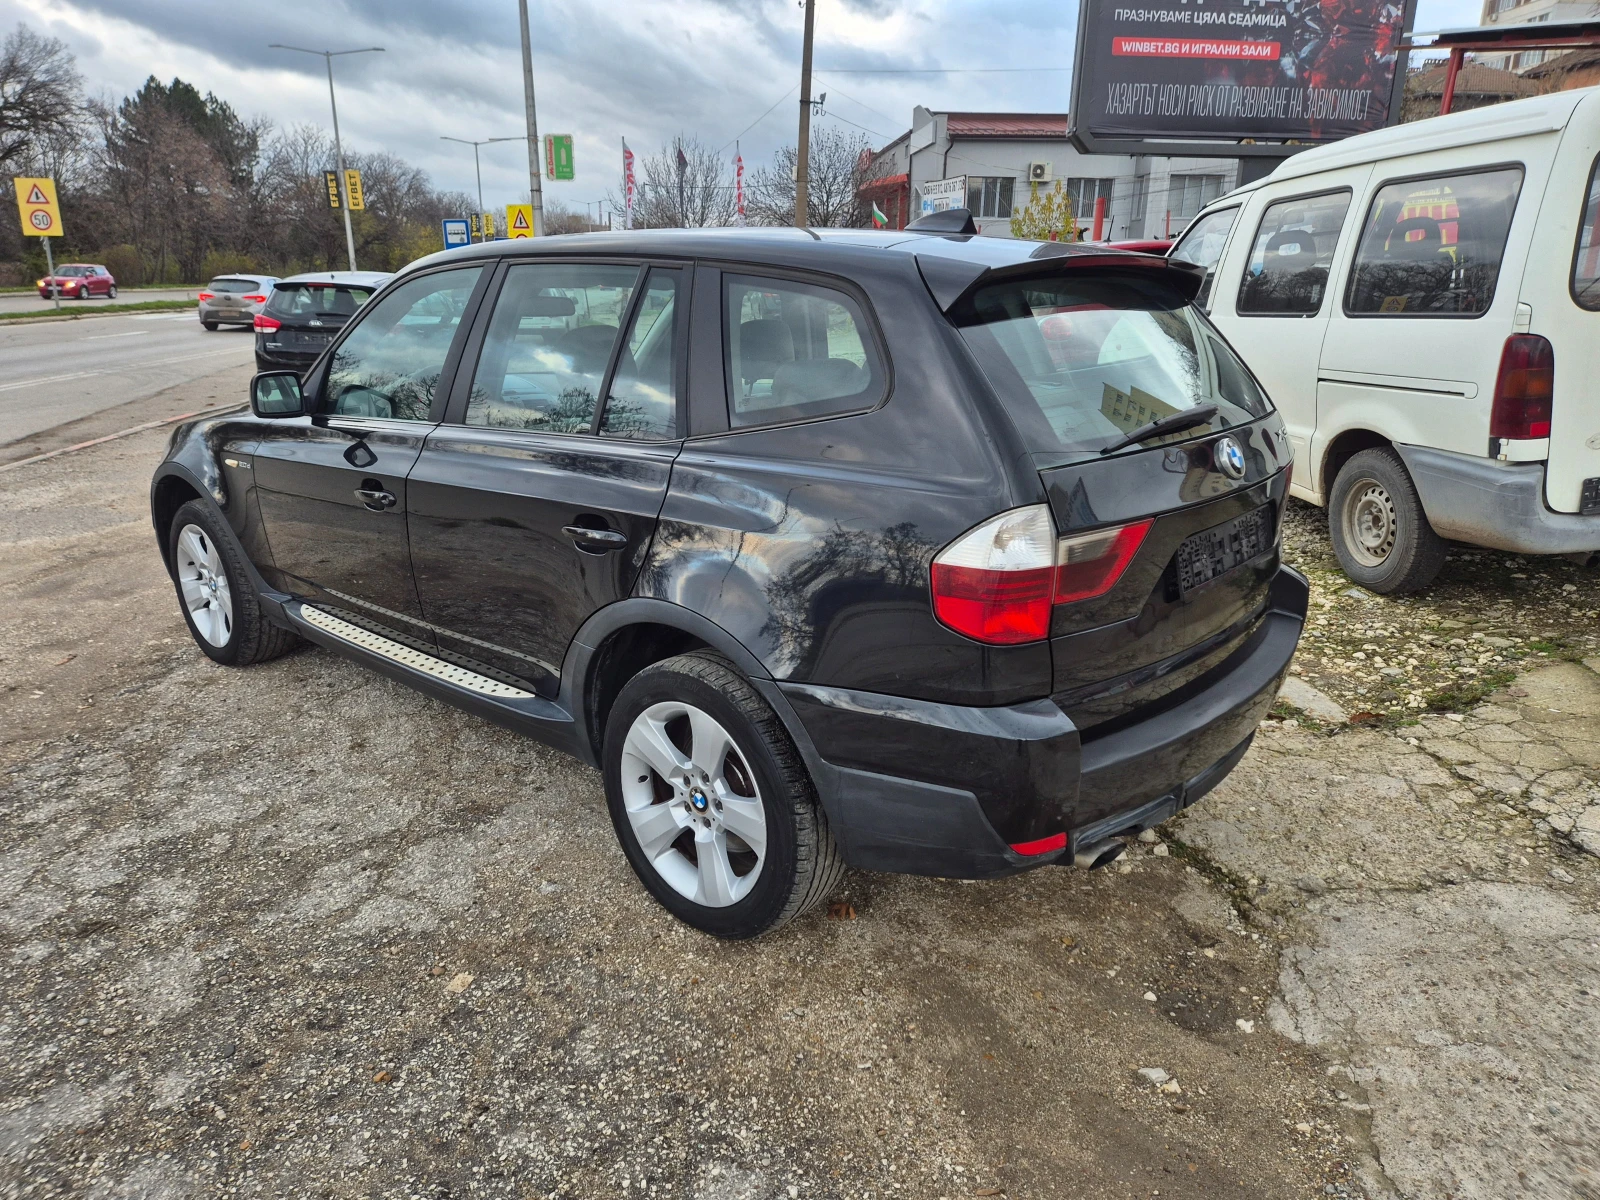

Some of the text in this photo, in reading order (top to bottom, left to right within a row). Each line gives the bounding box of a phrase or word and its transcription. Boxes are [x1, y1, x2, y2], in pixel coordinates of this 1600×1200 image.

[1114, 8, 1287, 29] ПРАЗНУВАМЕ ЦЯЛА СЕДМИЦА
[1121, 41, 1271, 57] WINBET.BG И ИГРАЛНИ ЗАЛИ
[1105, 83, 1372, 121] ХАЗАРТЪТ НОСИ РИСК ОТ РАЗВИВАНЕ НА ЗАВИСИМОСТ
[326, 172, 340, 208] EFBET
[348, 172, 360, 207] EFBET
[34, 214, 49, 226] 50
